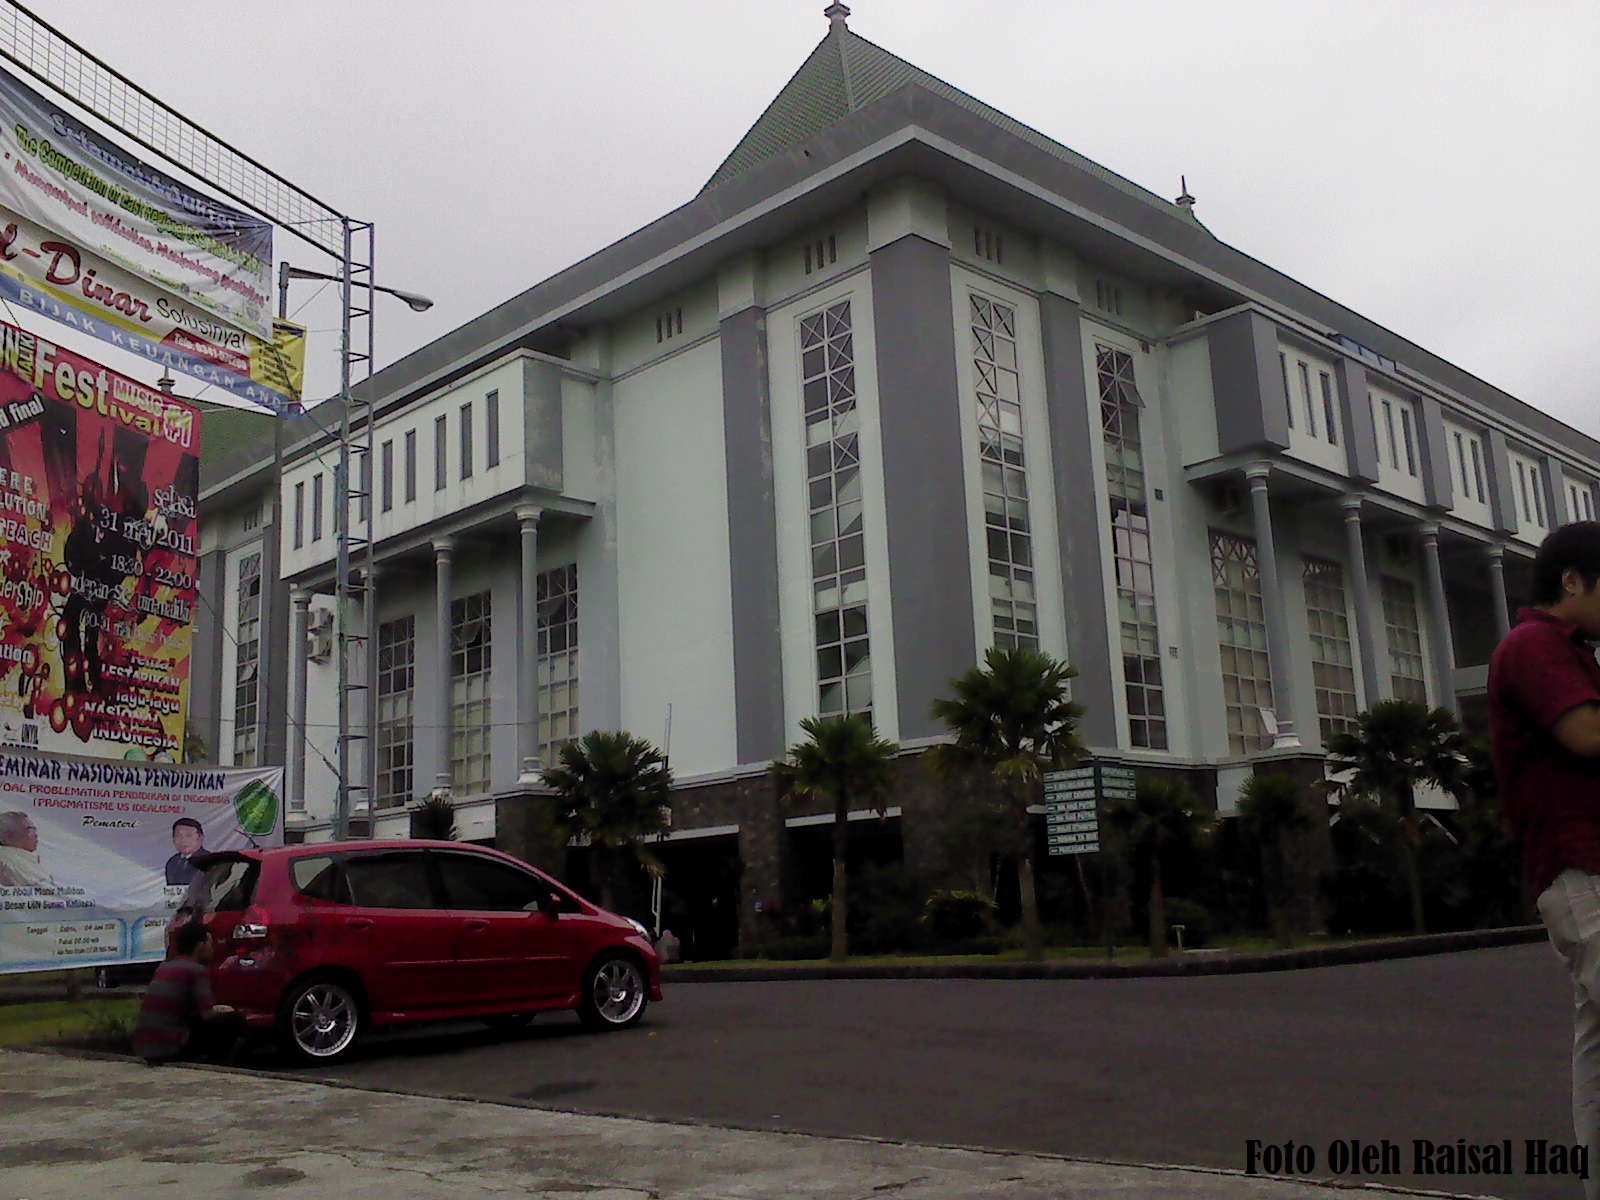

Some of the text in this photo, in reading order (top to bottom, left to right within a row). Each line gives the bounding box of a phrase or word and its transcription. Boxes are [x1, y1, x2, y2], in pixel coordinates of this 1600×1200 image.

[19, 288, 96, 333] BIJAK
[111, 330, 235, 389] KEUANGAN
[9, 394, 45, 422] final
[113, 376, 163, 417] MUSIC
[156, 529, 194, 554] 2011
[67, 762, 141, 787] NASIONAL
[143, 767, 226, 791] PENDIDIKAN
[29, 784, 110, 798] PROBLEMATIKA
[113, 790, 170, 801] PENDIDIKAN
